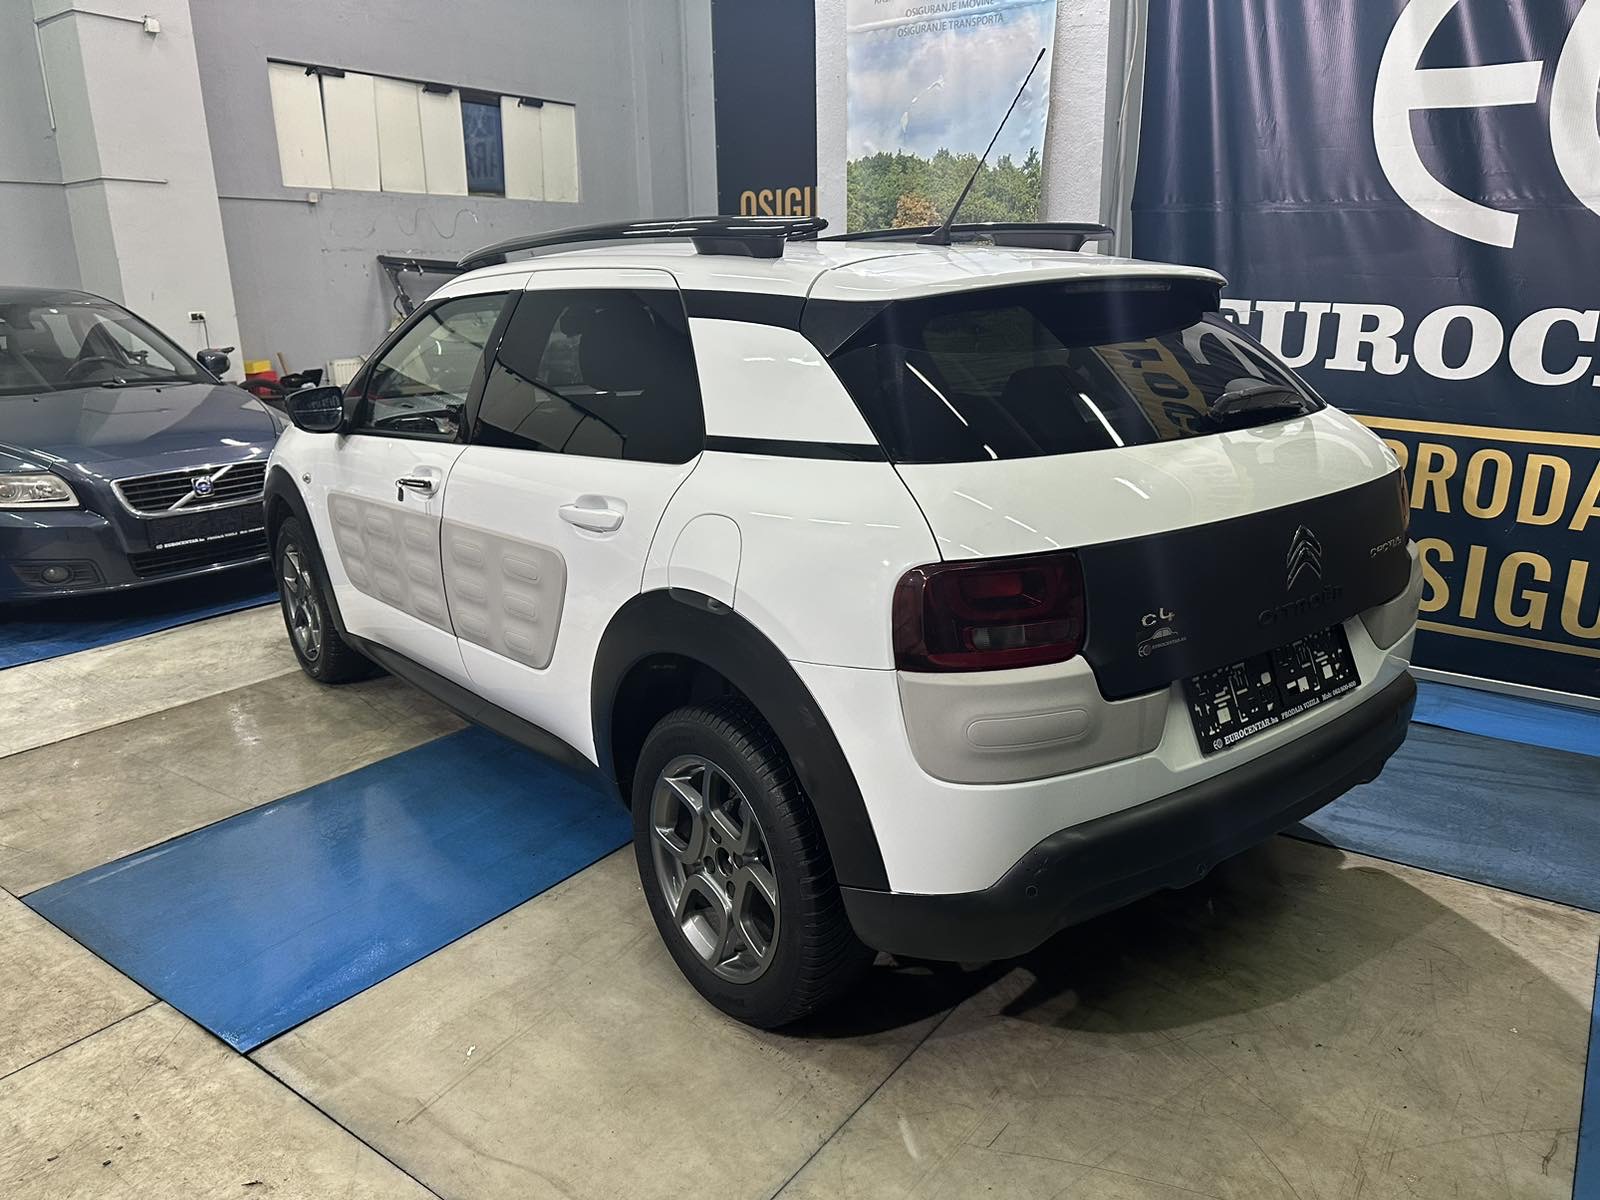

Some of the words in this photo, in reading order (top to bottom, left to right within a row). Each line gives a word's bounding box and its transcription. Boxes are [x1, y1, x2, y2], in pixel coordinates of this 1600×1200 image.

[897, 20, 947, 37] OSIGURANJE
[948, 13, 1004, 30] TRANSPORTA
[905, 2, 957, 17] OSIGURANJE
[1220, 299, 1600, 386] UROC
[1415, 538, 1600, 640] SIGU
